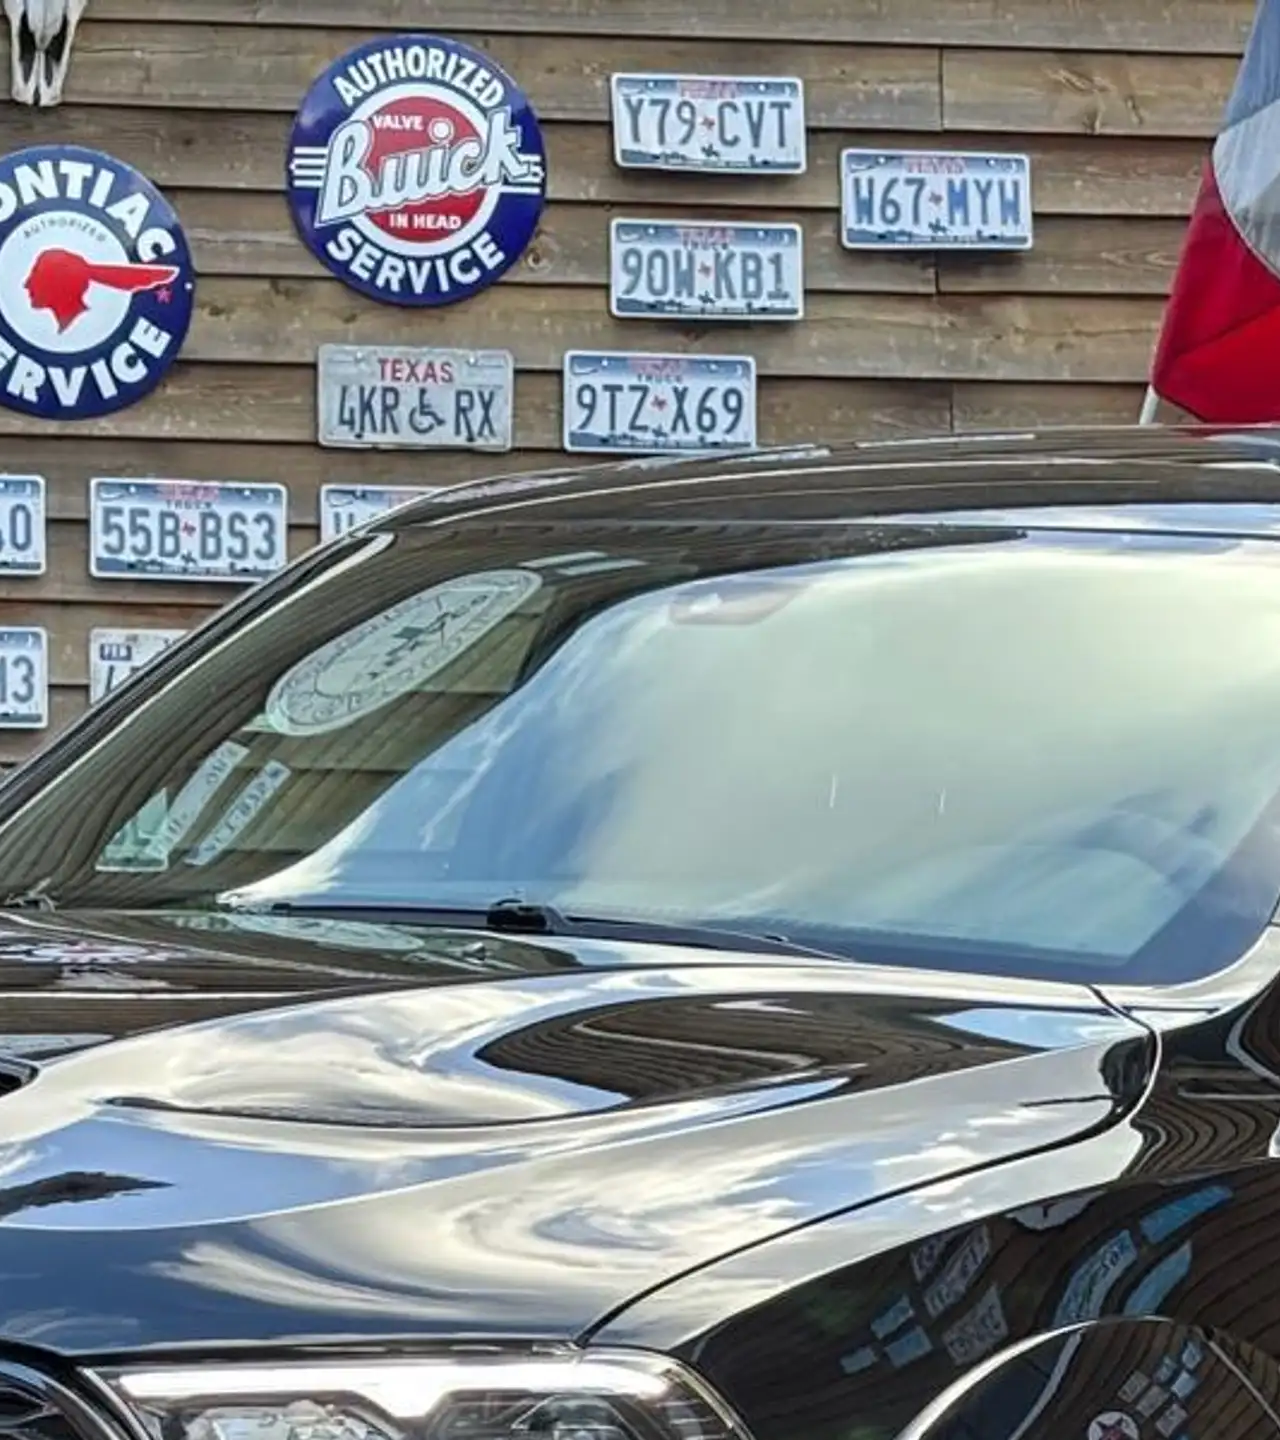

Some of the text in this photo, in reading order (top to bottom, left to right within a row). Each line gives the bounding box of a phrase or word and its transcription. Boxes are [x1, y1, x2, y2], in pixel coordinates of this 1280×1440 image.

[333, 47, 504, 108] AUTHORIZED
[373, 115, 424, 131] VALVE
[314, 106, 531, 228] Buick
[23, 216, 107, 242] AUTHORIZED
[389, 214, 461, 230] IN HEAD
[326, 228, 505, 293] SERVICE
[378, 358, 453, 384] TEXAS
[339, 386, 497, 438] 4KR RX
